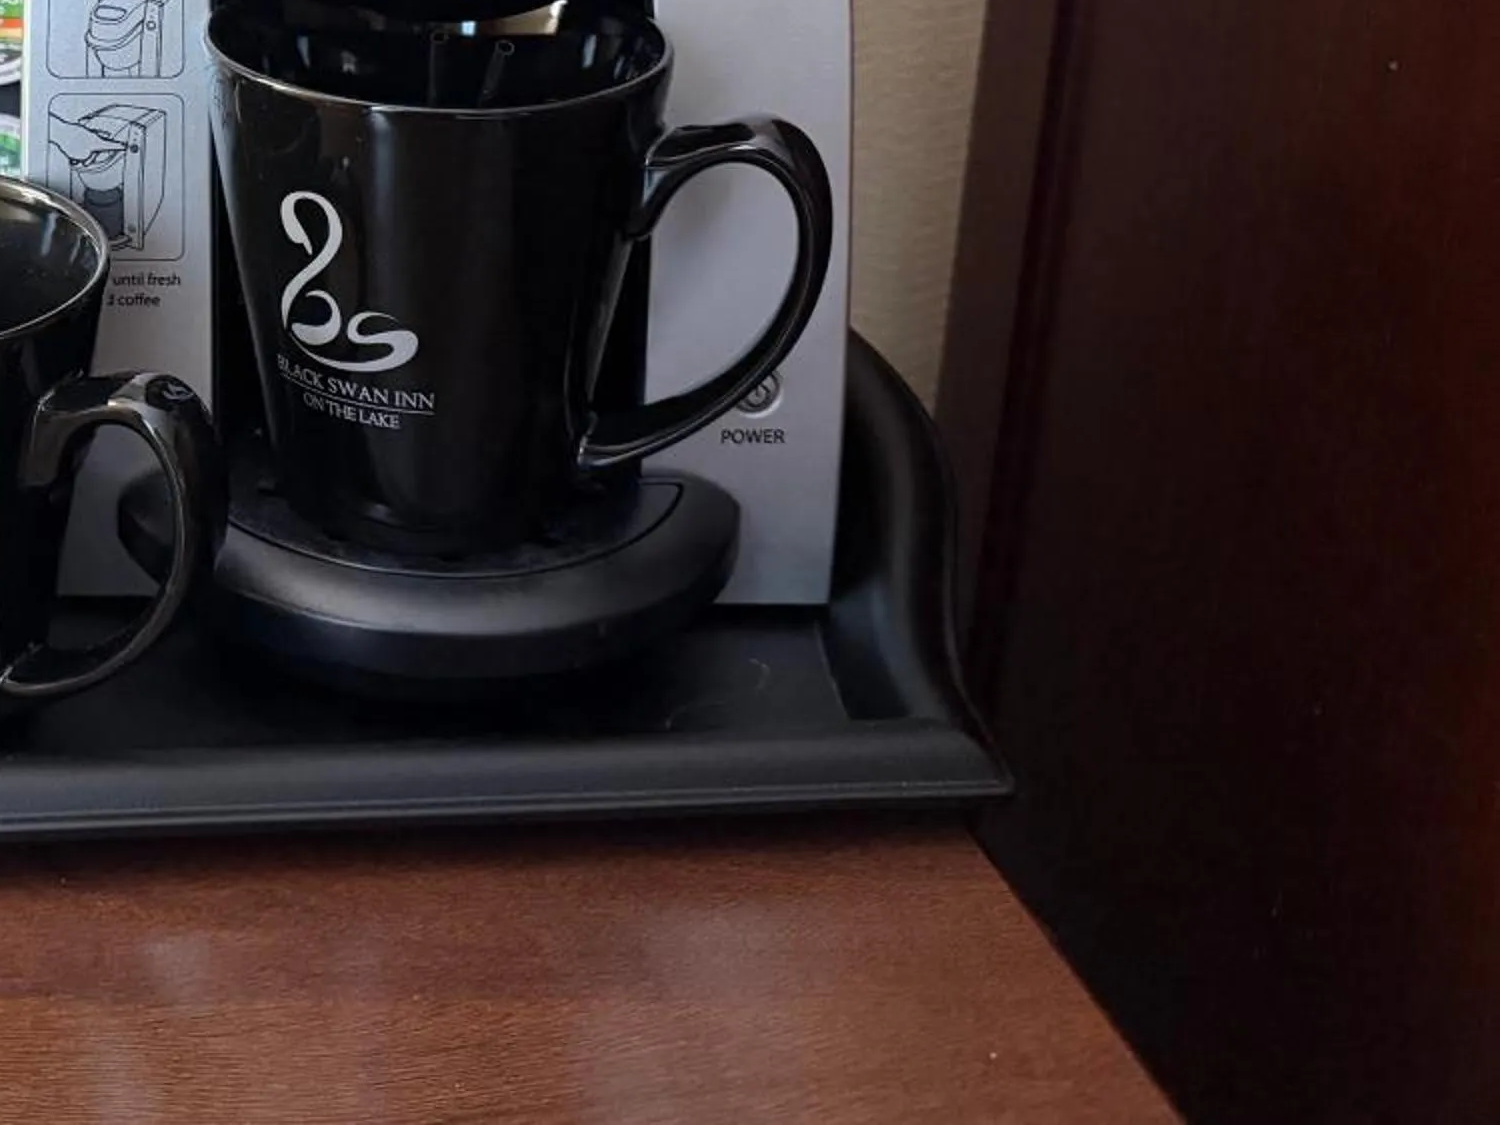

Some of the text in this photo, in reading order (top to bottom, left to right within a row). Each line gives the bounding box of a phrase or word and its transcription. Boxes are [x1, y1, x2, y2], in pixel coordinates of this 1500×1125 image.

[113, 272, 182, 286] until fresh
[117, 293, 161, 307] coffee
[327, 377, 389, 405] SWAN
[394, 390, 436, 409] INN
[303, 392, 402, 430] ON THE LAKE
[720, 428, 786, 445] POWER
